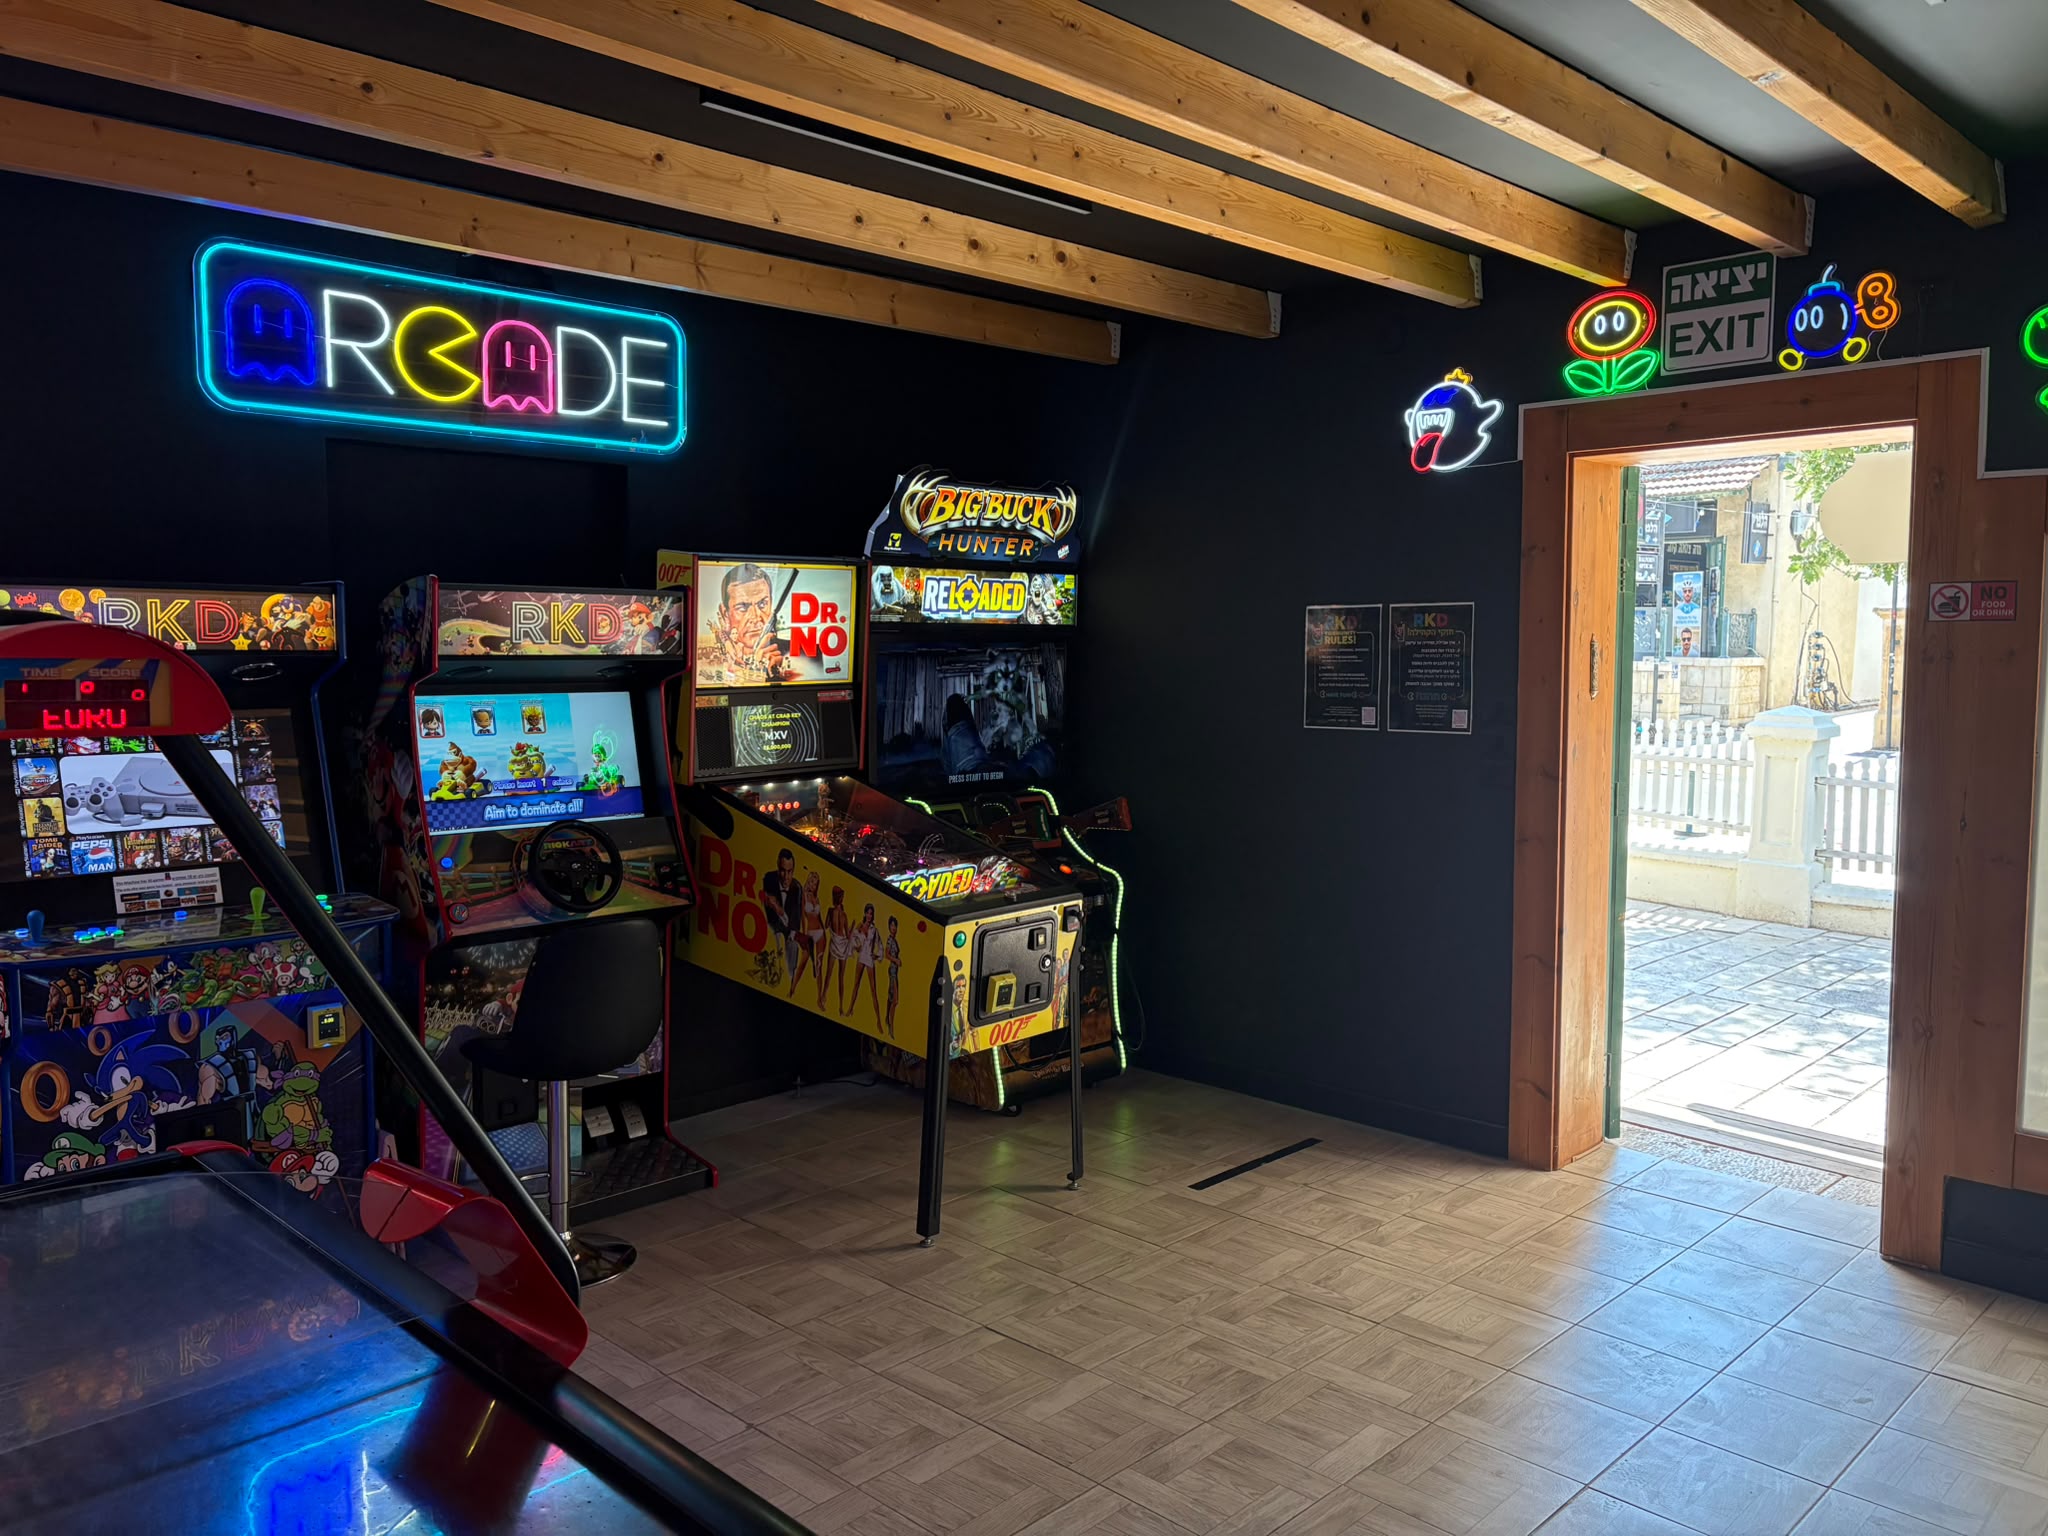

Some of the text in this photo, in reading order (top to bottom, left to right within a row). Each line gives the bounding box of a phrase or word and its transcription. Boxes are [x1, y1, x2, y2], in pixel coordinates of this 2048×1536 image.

[1670, 261, 1768, 305] יציאה
[1669, 311, 1765, 359] EXIT
[921, 486, 1057, 540] BIG BUCK
[937, 533, 1036, 557] HUNTER
[658, 562, 692, 583] 007
[923, 576, 1026, 614] RELOADED
[1981, 586, 2008, 600] NO
[1981, 600, 2006, 608] FOOD
[1986, 608, 2015, 616] DRINK
[98, 597, 240, 645] RKD
[511, 601, 622, 645] RKD
[1413, 613, 1448, 628] RKD
[789, 625, 848, 657] NO
[1324, 635, 1358, 645] RULES!
[21, 667, 60, 678] TIME
[88, 667, 142, 678] SCORE
[948, 771, 1004, 784] PRESS START TO BEGIN
[484, 798, 584, 822] Aim to dominate all!
[32, 842, 63, 852] RAIDER
[71, 840, 112, 851] PEPSI
[88, 863, 114, 873] MAN
[697, 885, 769, 954] NO
[989, 1014, 1038, 1047] 007
